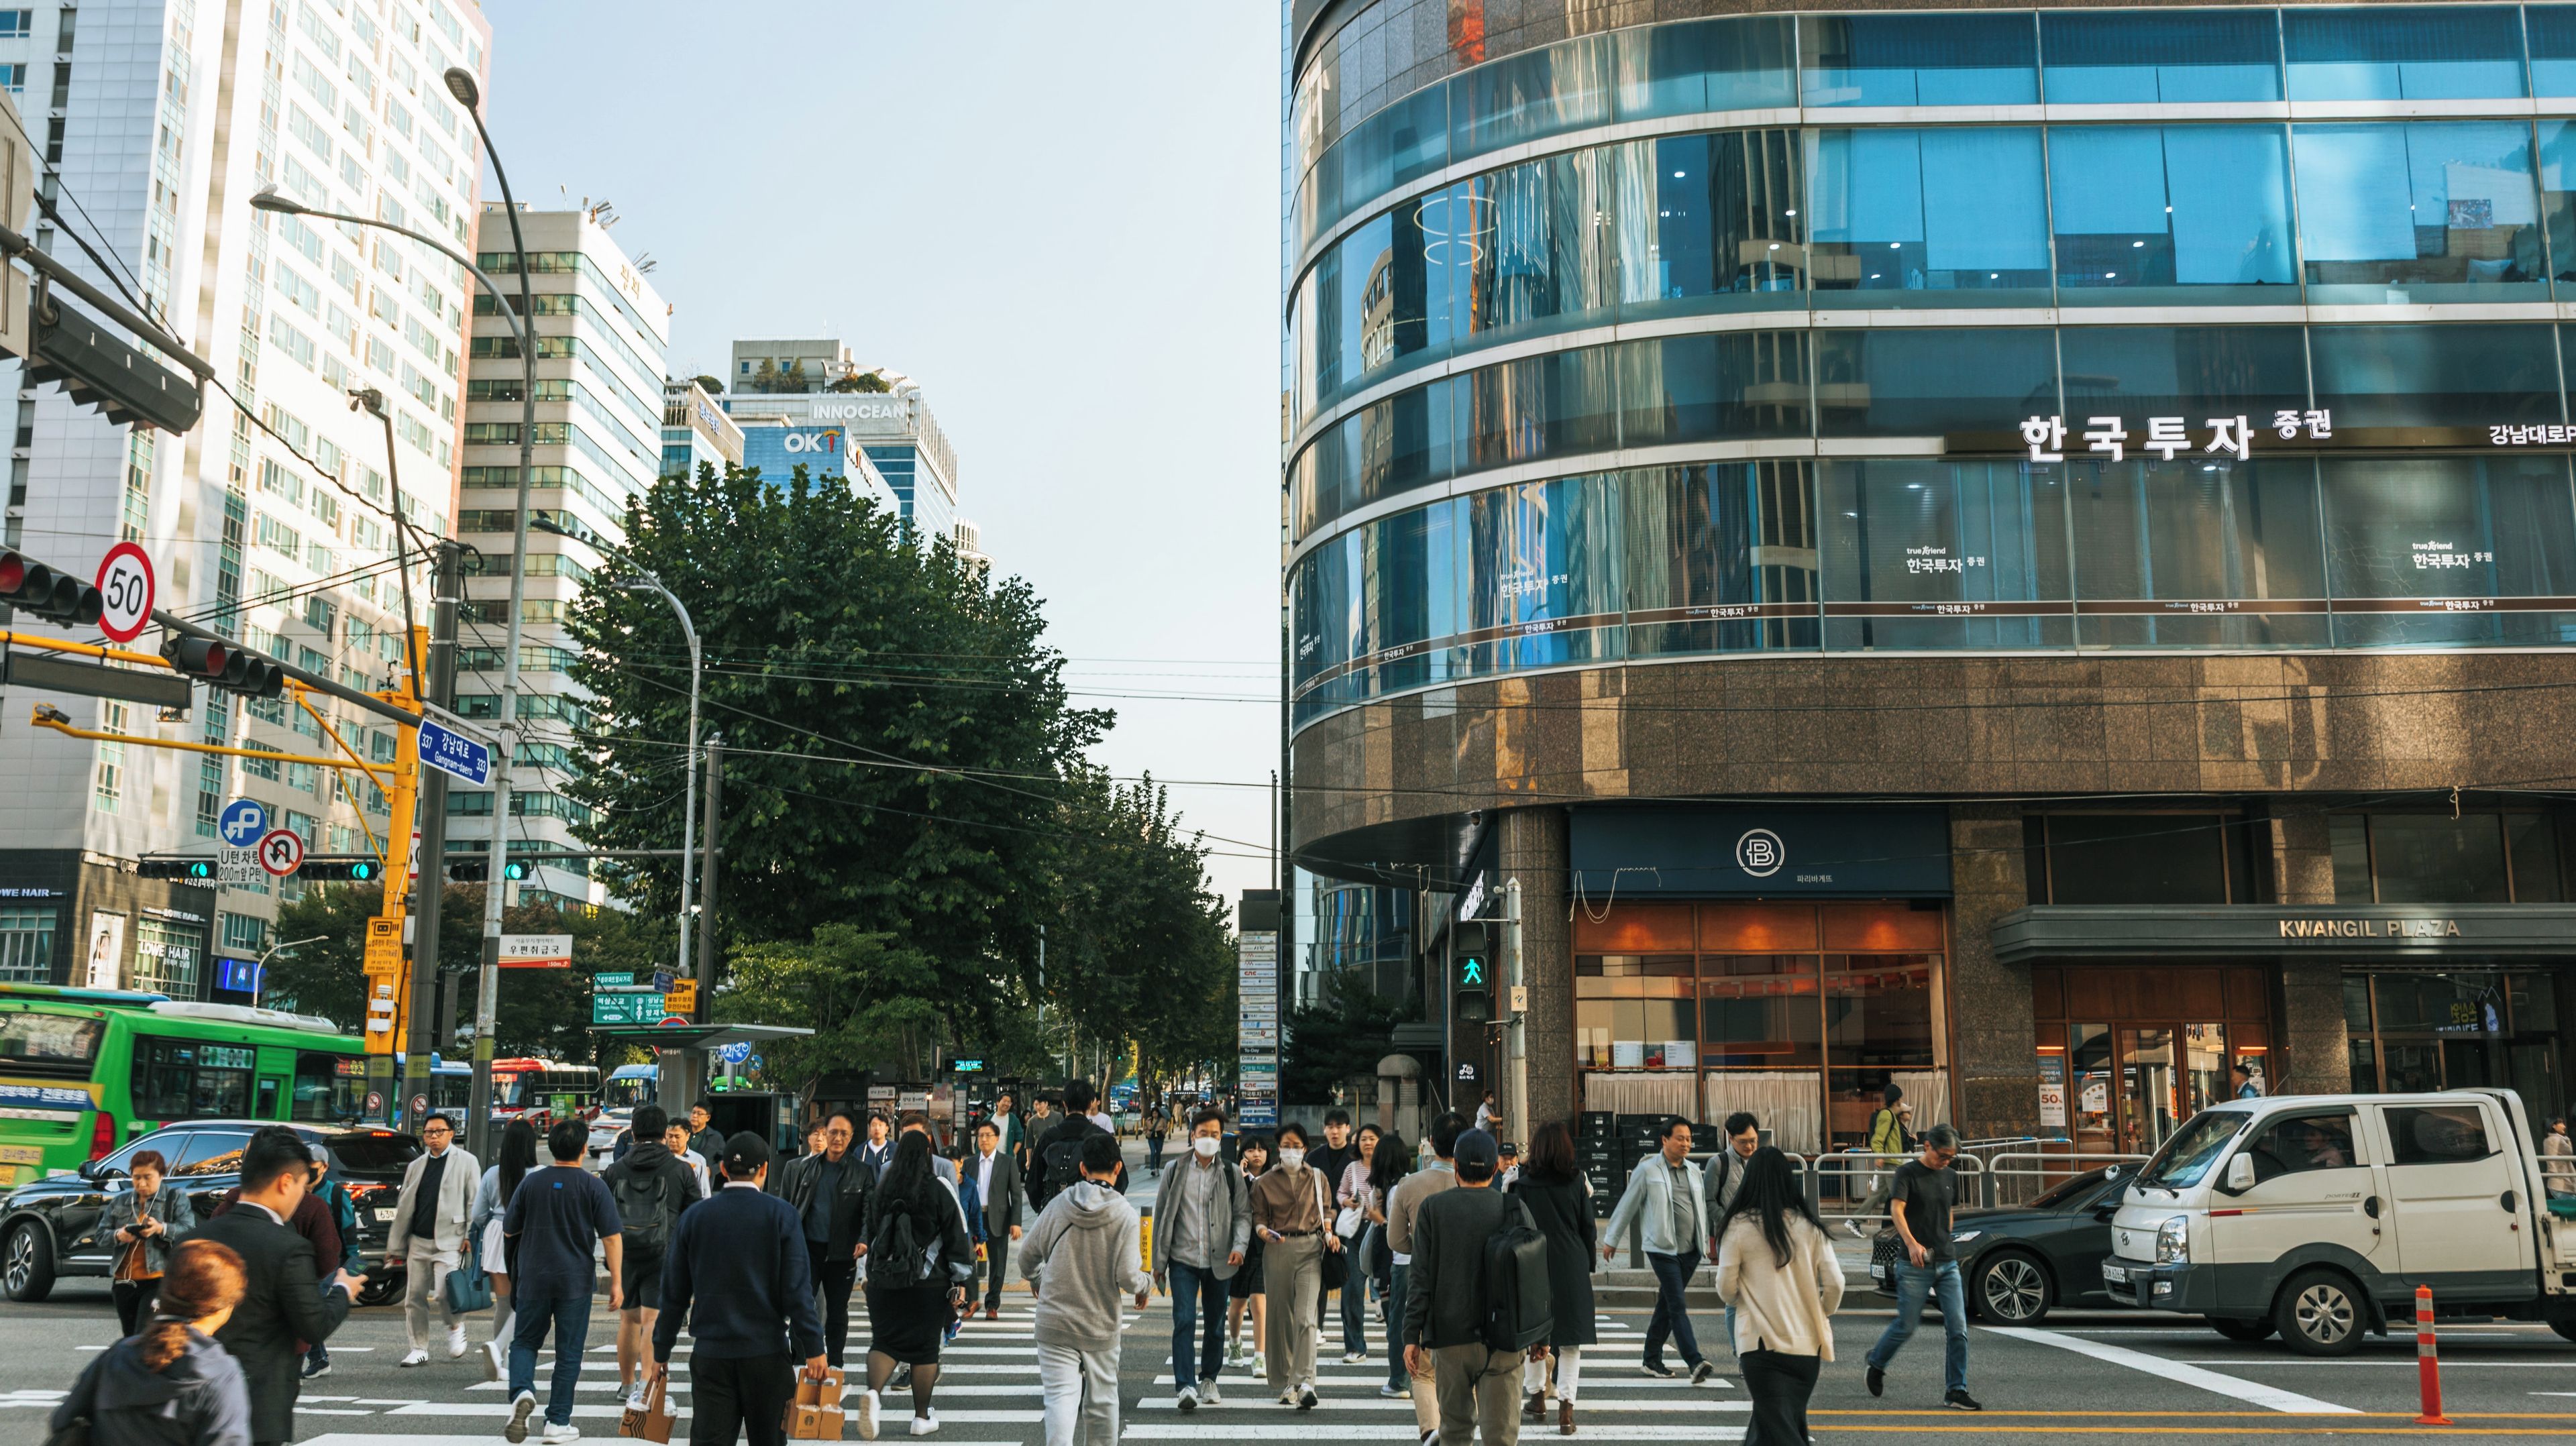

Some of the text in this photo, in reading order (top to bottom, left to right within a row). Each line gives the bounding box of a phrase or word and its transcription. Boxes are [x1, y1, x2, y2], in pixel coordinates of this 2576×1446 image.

[813, 404, 906, 419] INNOCEAN
[2019, 408, 2332, 463] 한국투자 증권
[1907, 556, 1985, 573] 한국투자 증권
[2412, 552, 2493, 569] 한국투자 증권
[107, 567, 144, 616] 50
[1501, 573, 1568, 598] 한국투자 증권
[1710, 607, 1744, 618] 한국투자
[1937, 604, 1971, 614] 한국투자
[2190, 603, 2224, 612] 한국투자
[2445, 600, 2479, 610] 한국투자
[1525, 622, 1554, 634] 한국투자
[1384, 648, 1405, 661] 한국투자
[421, 733, 486, 773] 337 강남대로 333
[435, 750, 473, 776] Gangnam-daero
[221, 850, 239, 865] U턴
[219, 867, 247, 881] 200m앞
[1797, 875, 1833, 883] 파리바게뜨
[21, 889, 49, 897] HAIR
[2279, 920, 2461, 938] KWANGIL PLAZA
[139, 942, 190, 960] LOWE HAIR
[510, 945, 559, 955] 우편취급국
